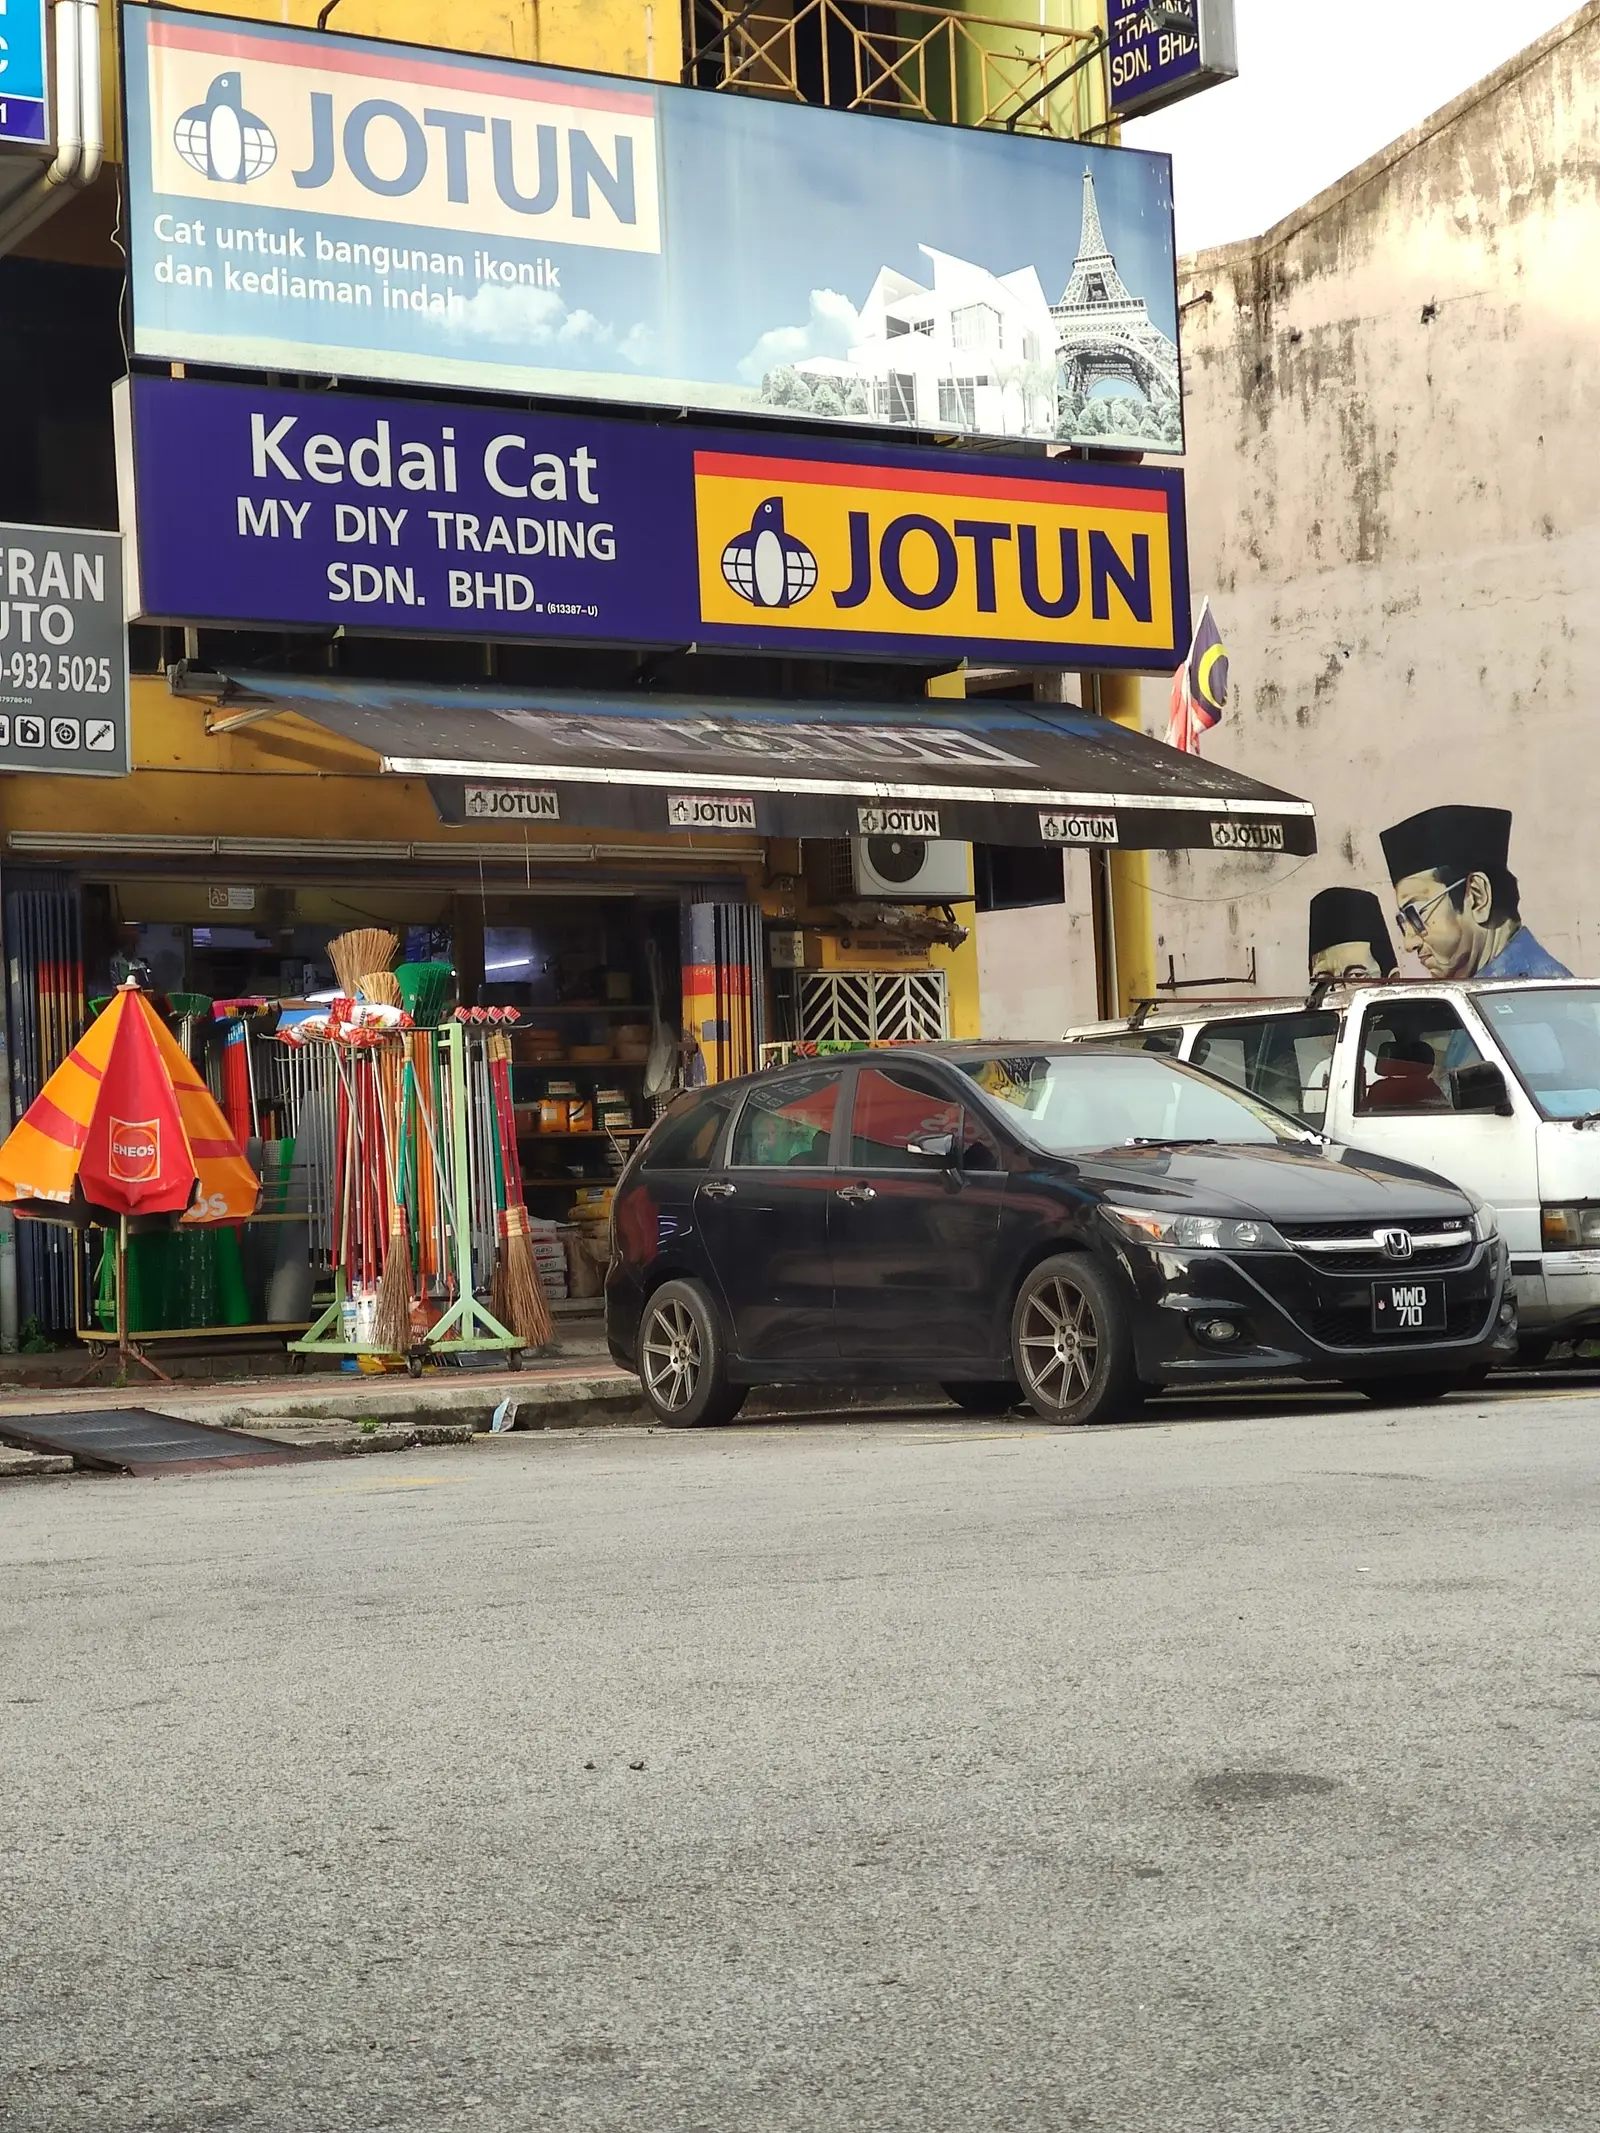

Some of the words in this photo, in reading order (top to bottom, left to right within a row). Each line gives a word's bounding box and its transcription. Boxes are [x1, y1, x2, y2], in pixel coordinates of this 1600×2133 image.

[1112, 44, 1151, 87] SDN.
[291, 91, 637, 225] JOTUN
[153, 214, 206, 246] Cat
[216, 227, 306, 258] untuk
[315, 231, 464, 276] bangunan
[474, 250, 561, 287] ikonik
[153, 255, 213, 289] dan
[224, 260, 372, 306] kediaman
[383, 279, 465, 316] indah
[250, 412, 458, 493] Kedai
[483, 434, 600, 505] Cat
[237, 496, 312, 540] MY
[335, 504, 408, 546] DIY
[427, 510, 617, 561] TRADING
[0, 547, 105, 602] RAN
[831, 510, 1154, 624] JOTUN
[326, 562, 426, 606] SDN.
[448, 570, 544, 613] BHD.
[547, 602, 599, 617] (613387-U)
[0, 651, 52, 691] -932
[57, 654, 112, 695] 5025
[490, 793, 556, 814] JOTUN
[693, 803, 753, 823] JOTUN
[880, 812, 937, 832] JOTUN
[1061, 819, 1115, 838] JOTUN
[1232, 826, 1282, 844] JOTUN
[112, 1141, 155, 1158] ENEOS
[1396, 1306, 1423, 1326] 710
